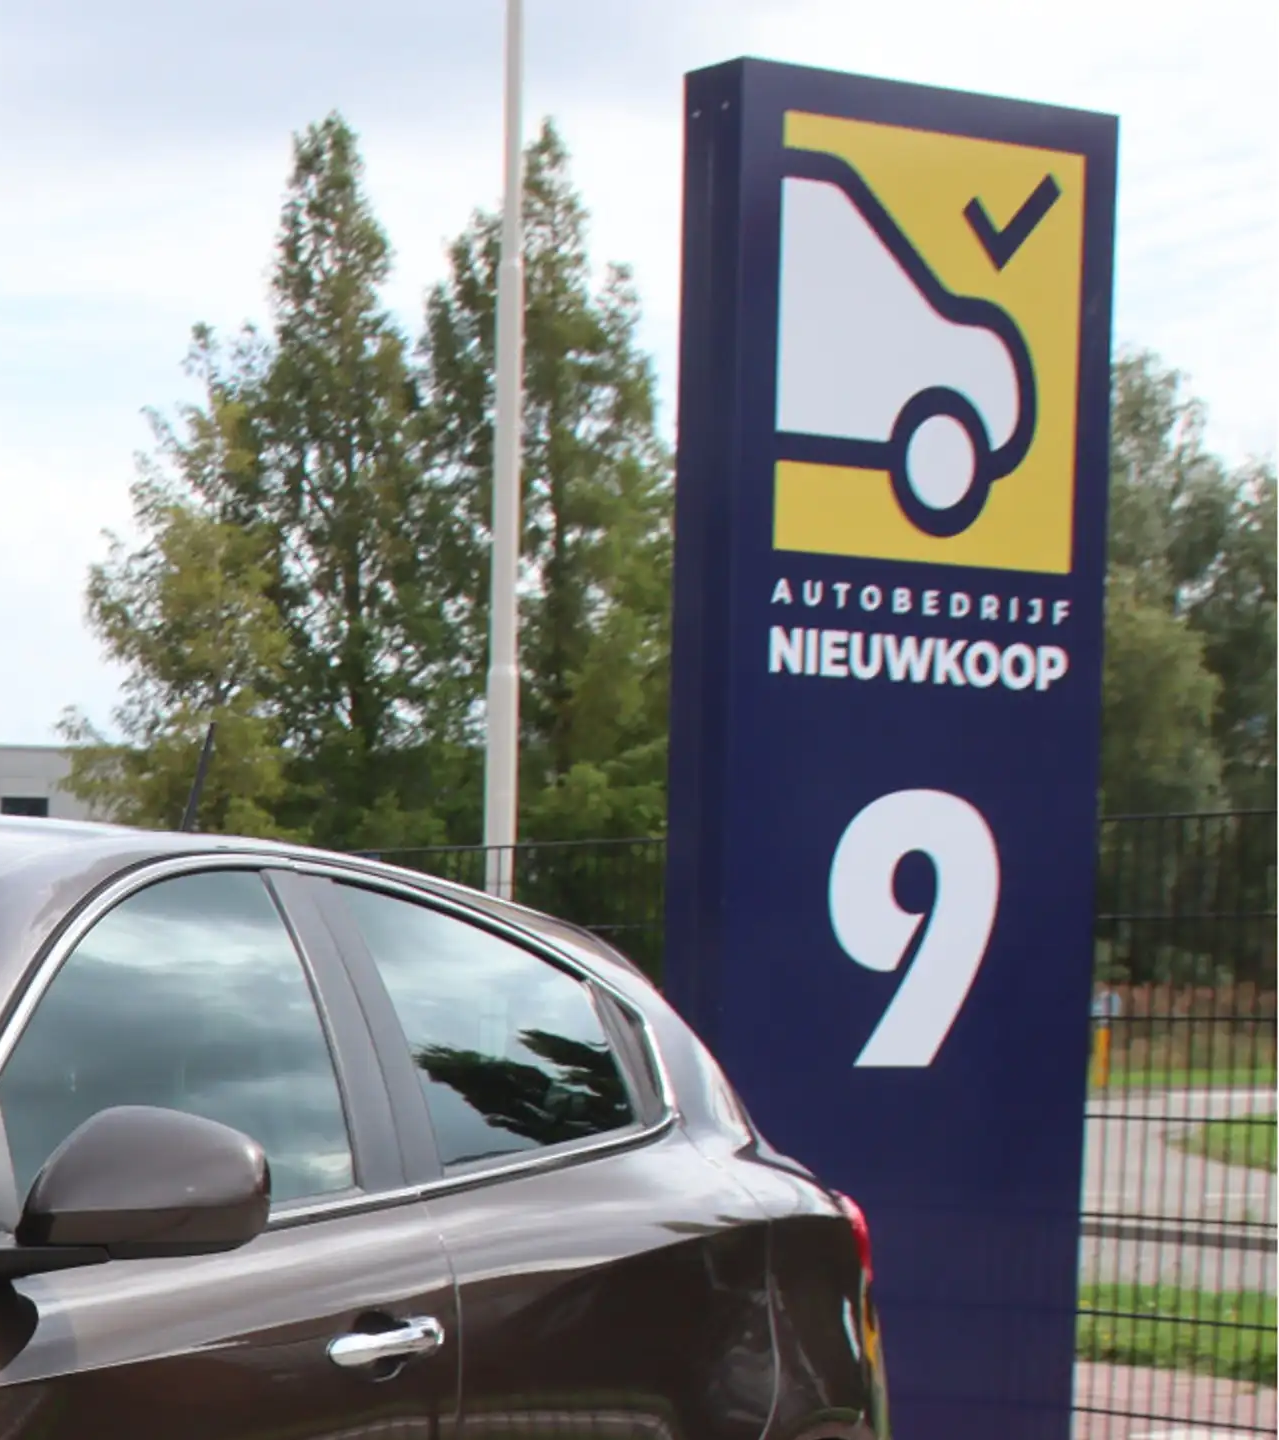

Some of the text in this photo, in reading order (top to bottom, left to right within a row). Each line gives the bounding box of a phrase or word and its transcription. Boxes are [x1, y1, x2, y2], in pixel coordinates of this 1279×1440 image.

[770, 577, 1072, 625] AUTOBEDRIJF
[768, 626, 1068, 691] NIEUWKOOP
[828, 788, 1001, 1067] 9
